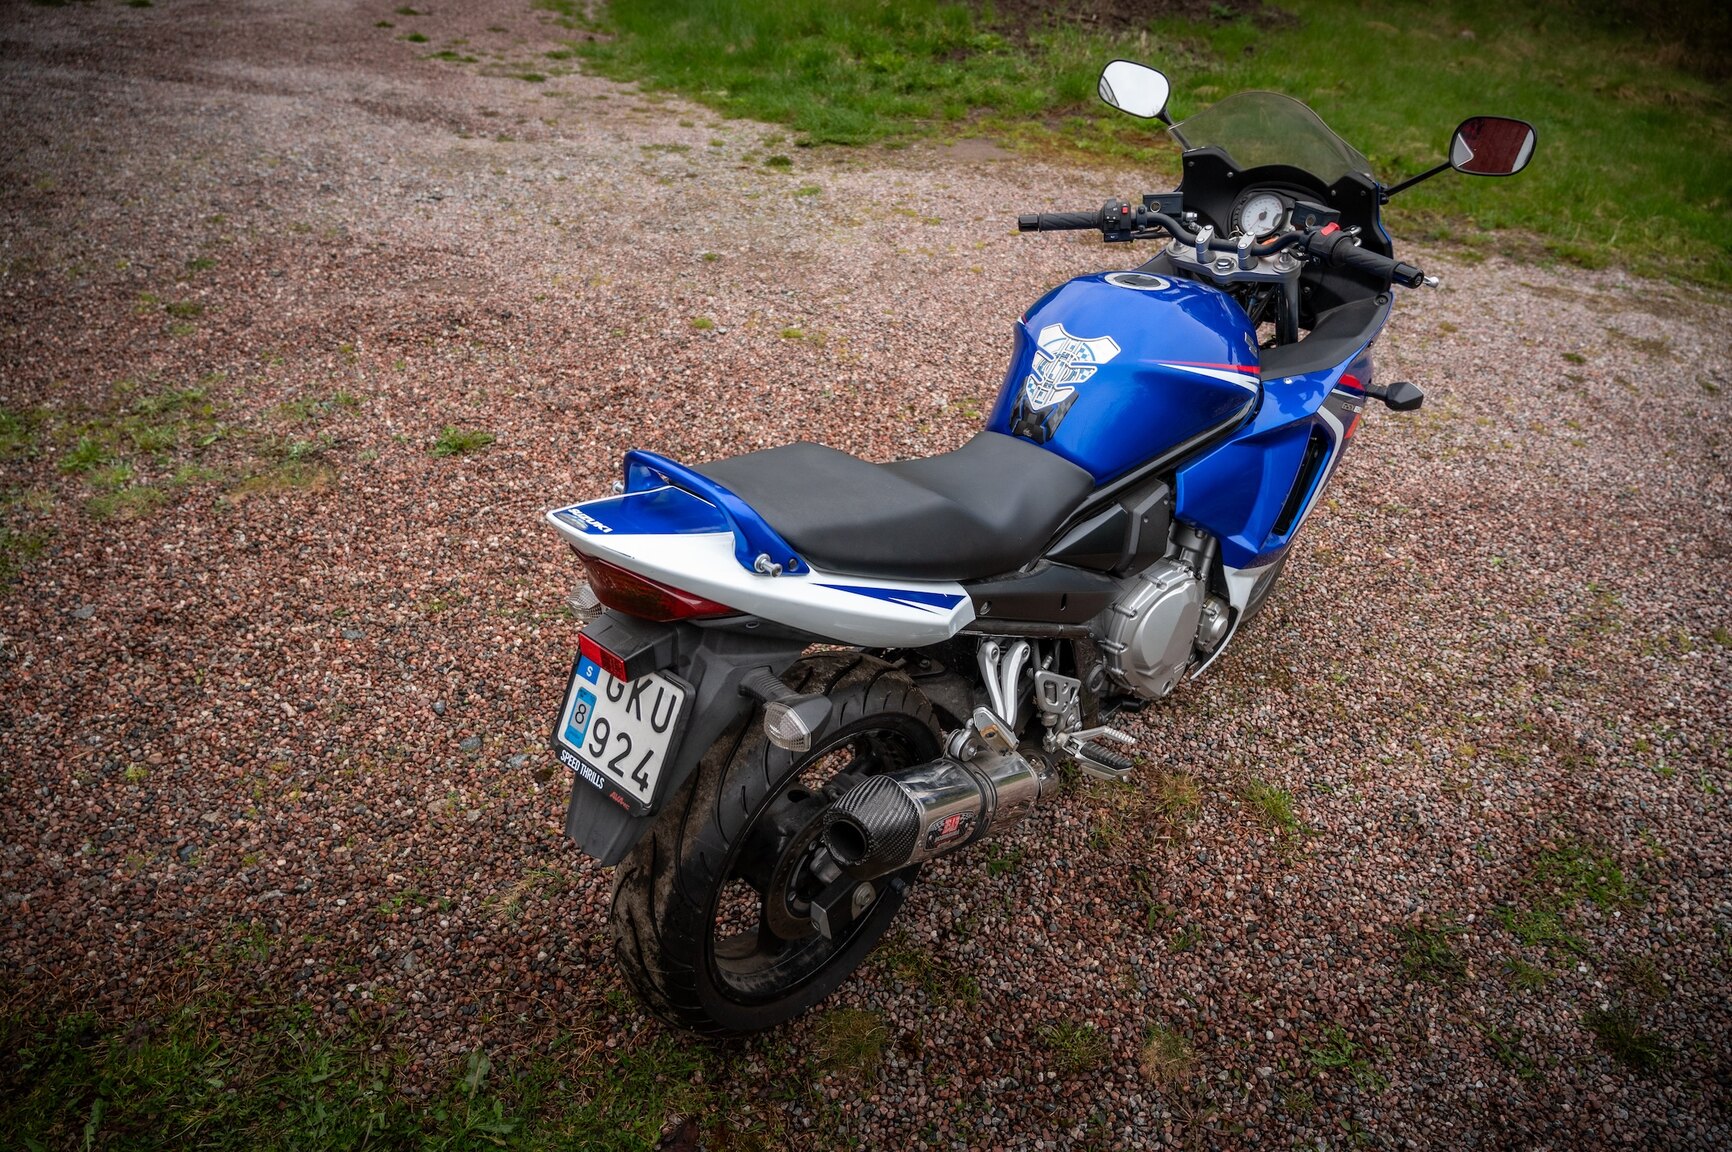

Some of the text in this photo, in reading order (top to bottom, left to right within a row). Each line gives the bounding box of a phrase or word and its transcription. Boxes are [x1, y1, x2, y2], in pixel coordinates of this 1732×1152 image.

[568, 509, 613, 533] SUZUKI
[586, 666, 593, 677] S
[574, 703, 587, 725] 8
[606, 675, 677, 733] GKU
[560, 749, 605, 789] SPEED THRILLS
[588, 717, 655, 793] 924
